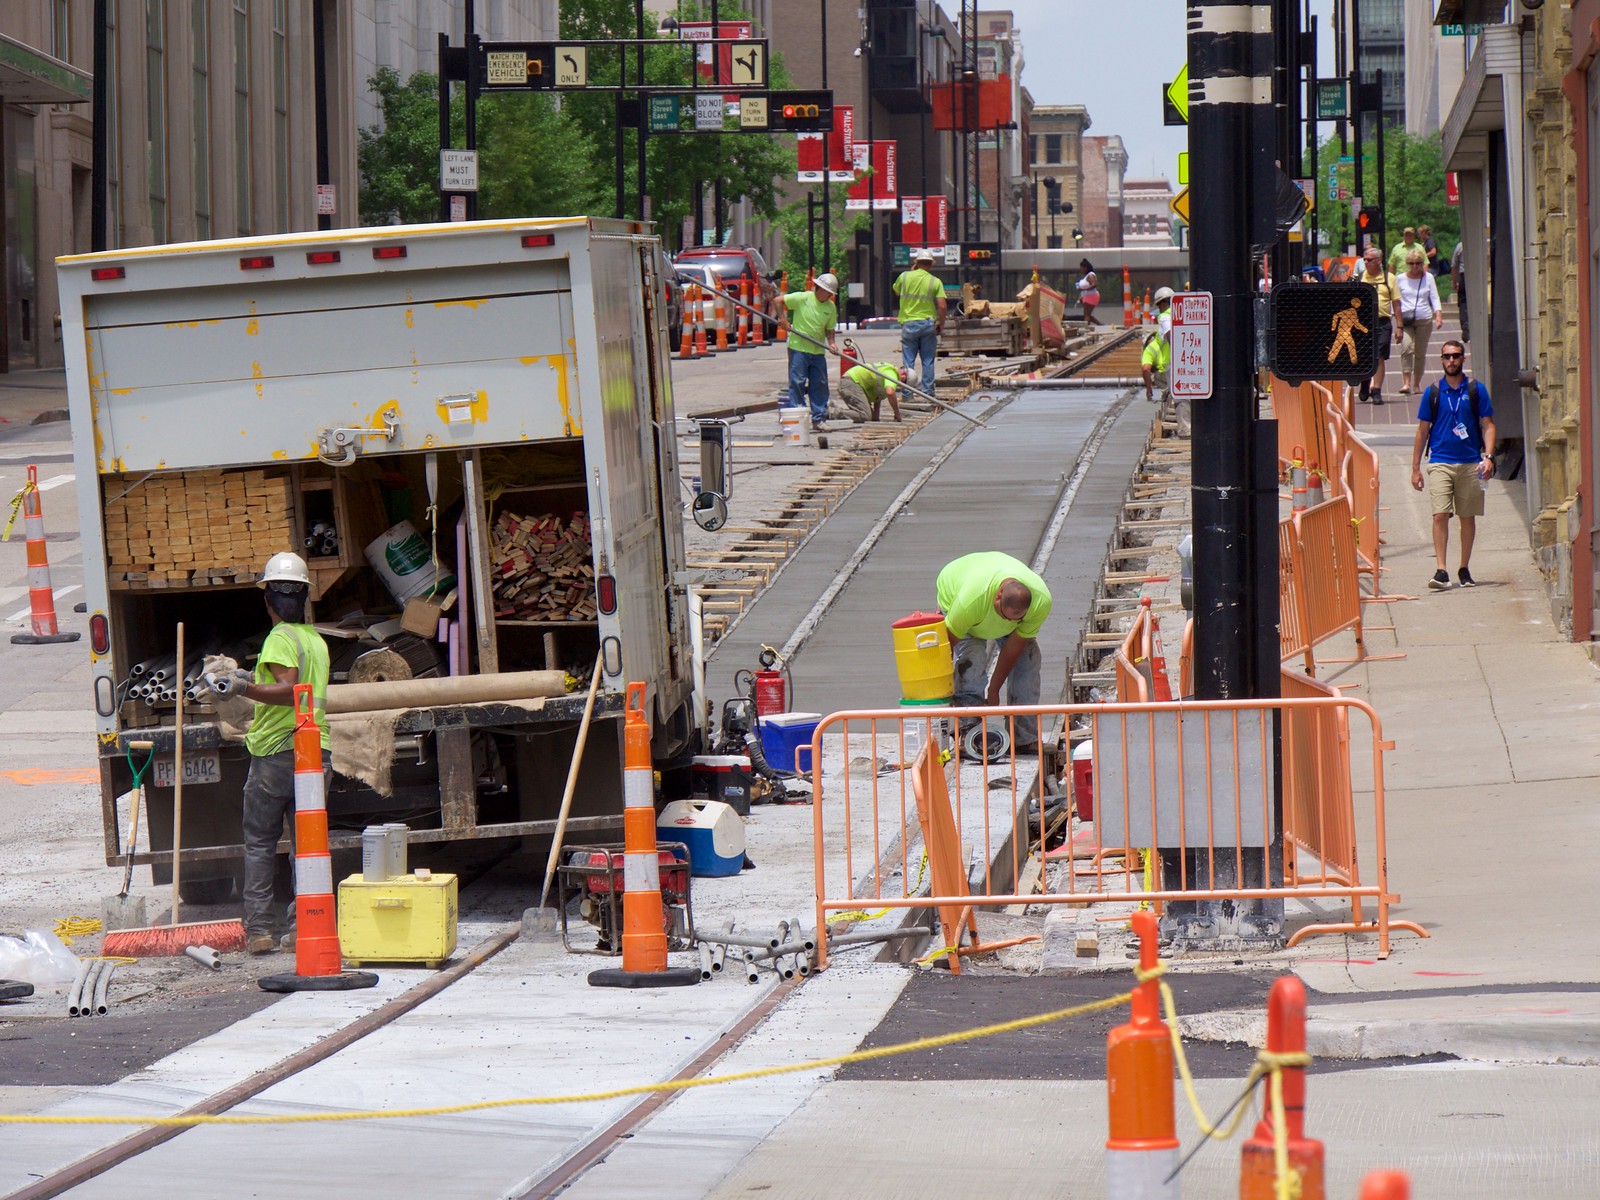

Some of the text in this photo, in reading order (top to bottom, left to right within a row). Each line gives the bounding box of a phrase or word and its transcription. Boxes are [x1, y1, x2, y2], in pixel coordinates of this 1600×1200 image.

[489, 69, 525, 77] VEHICLE
[698, 99, 721, 107] DO NOT
[698, 110, 722, 118] BLOCK
[449, 166, 469, 174] MUST
[1172, 299, 1208, 320] NO STOPPING
[1186, 311, 1207, 320] PARKING
[1181, 382, 1202, 390] TOW ZONE
[158, 759, 215, 778] PF 6442
